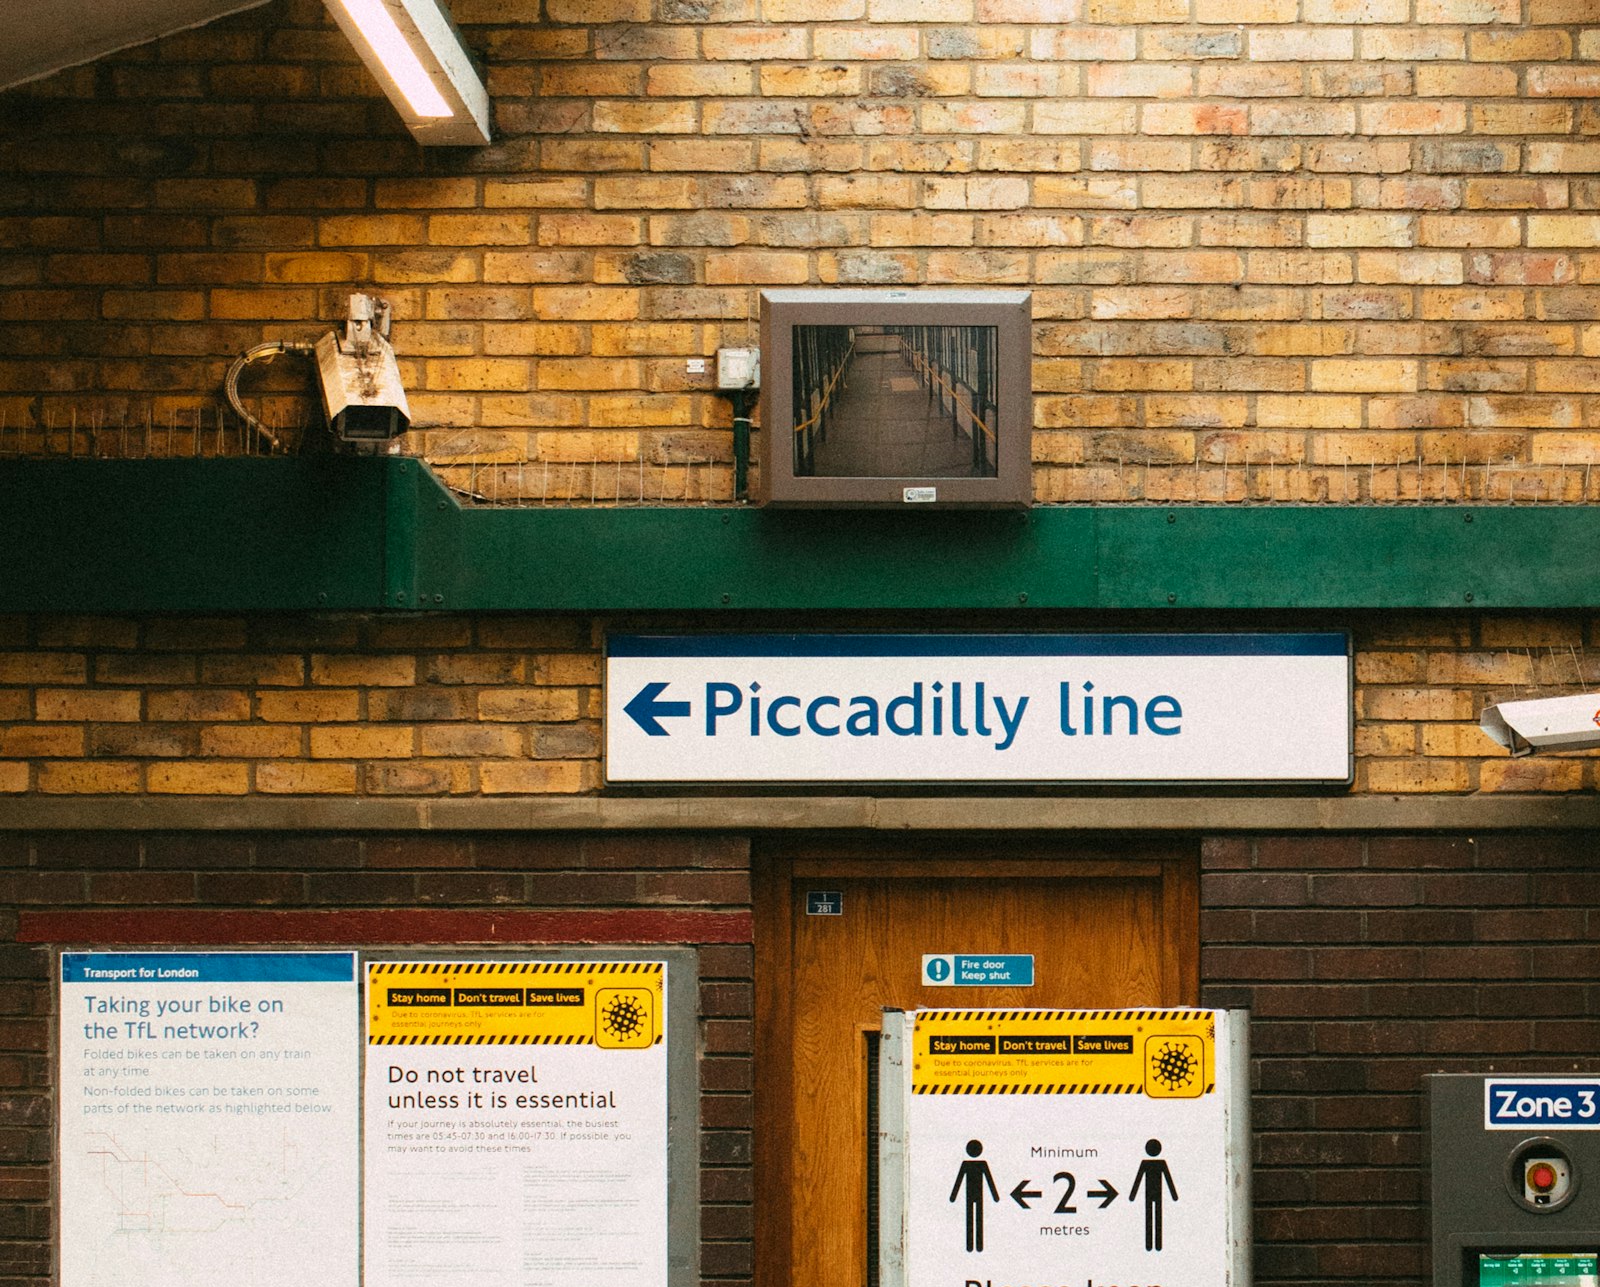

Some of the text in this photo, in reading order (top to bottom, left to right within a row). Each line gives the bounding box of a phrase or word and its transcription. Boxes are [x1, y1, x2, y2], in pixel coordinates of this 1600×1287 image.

[706, 681, 1182, 750] Piccadilly line
[817, 905, 832, 913] 281
[961, 958, 1005, 970] Fire door
[83, 966, 199, 981] Transport for London
[961, 969, 1011, 982] Keep shut
[391, 993, 580, 1005] Stay home Don't travel Save lives
[84, 996, 283, 1017] Taking your bike on
[391, 1010, 407, 1020] Due
[408, 1010, 418, 1020] to
[471, 1010, 484, 1020] TfL
[484, 1010, 517, 1020] services
[519, 1010, 532, 1020] are
[532, 1010, 545, 1020] for
[84, 1021, 259, 1039] the TfL network?
[391, 1020, 427, 1029] essential
[427, 1020, 463, 1029] journeys
[933, 1041, 1129, 1052] Stay home Don't travel Save lives
[83, 1049, 311, 1062] Folded bikes can be taken on any train
[934, 1059, 950, 1068] Due
[952, 1059, 962, 1068] to
[1016, 1059, 1029, 1068] TfL
[1031, 1059, 1065, 1068] services
[1066, 1059, 1079, 1068] are
[1080, 1059, 1094, 1068] for
[83, 1066, 95, 1077] at
[98, 1067, 118, 1080] any
[389, 1066, 537, 1083] Do not travel
[934, 1068, 971, 1078] essential
[972, 1068, 1008, 1078] journeys
[83, 1086, 319, 1097] Non-folded bikes can be taken on some
[389, 1091, 616, 1108] unless it is essential
[1496, 1091, 1595, 1117] Zone 3
[83, 1102, 113, 1115] parts
[117, 1102, 130, 1114] of
[133, 1102, 152, 1114] the
[156, 1102, 205, 1114] network
[208, 1104, 222, 1114] as
[225, 1102, 292, 1116] highlighted
[387, 1120, 395, 1129] If
[396, 1120, 418, 1130] your
[419, 1120, 456, 1130] journey
[458, 1120, 467, 1129] is
[469, 1119, 518, 1130] absolutely
[566, 1120, 582, 1129] the
[585, 1120, 619, 1129] busiest
[387, 1132, 413, 1141] times
[415, 1133, 430, 1141] are
[488, 1132, 505, 1141] and
[560, 1132, 567, 1141] If
[614, 1133, 632, 1142] you
[387, 1145, 407, 1154] may
[410, 1144, 434, 1153] want
[435, 1144, 446, 1153] to
[448, 1144, 473, 1153] avoid
[476, 1144, 503, 1153] these
[1031, 1147, 1098, 1158] Minimum
[1053, 1172, 1077, 1213] 2
[1040, 1226, 1089, 1235] metres
